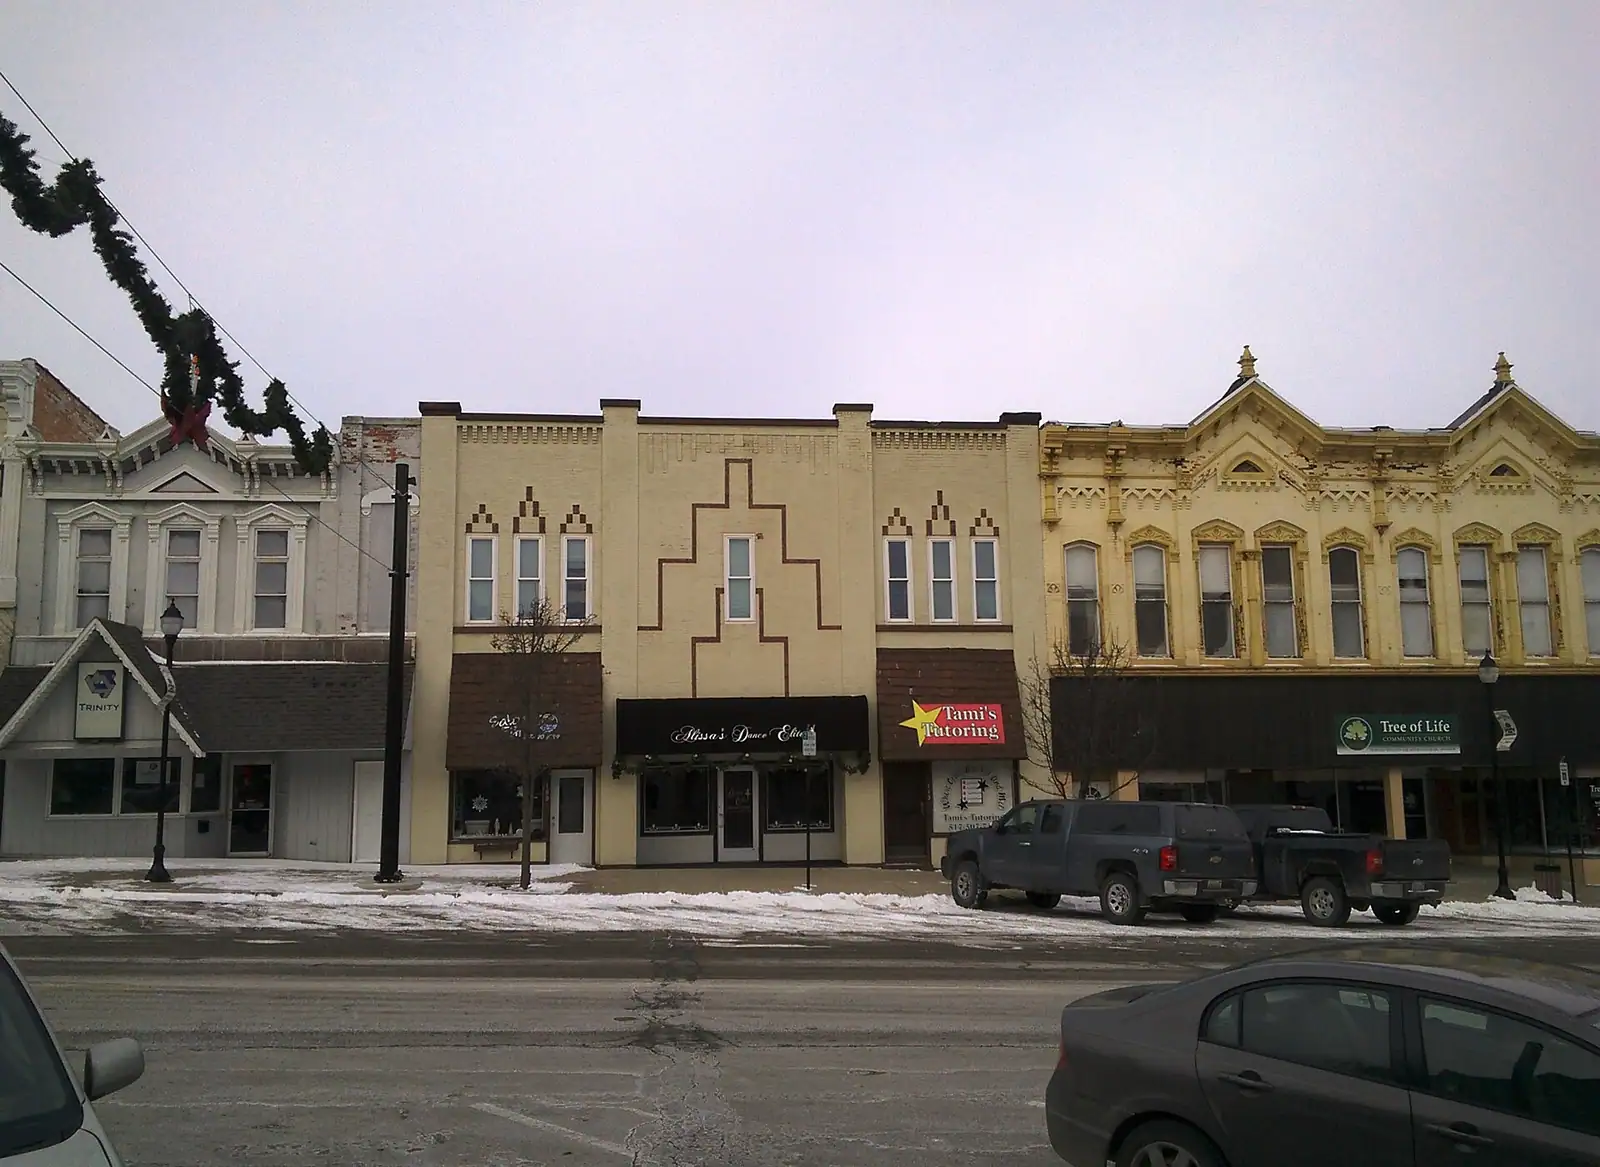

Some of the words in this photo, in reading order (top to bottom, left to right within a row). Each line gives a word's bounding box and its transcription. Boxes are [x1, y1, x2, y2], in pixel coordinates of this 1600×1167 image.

[942, 705, 997, 721] Tami's
[670, 724, 726, 744] Alissa's
[731, 724, 768, 743] Dance
[921, 722, 999, 741] Tutoring
[1380, 720, 1407, 733] Tree
[1410, 720, 1423, 733] of
[1426, 720, 1450, 733] Life
